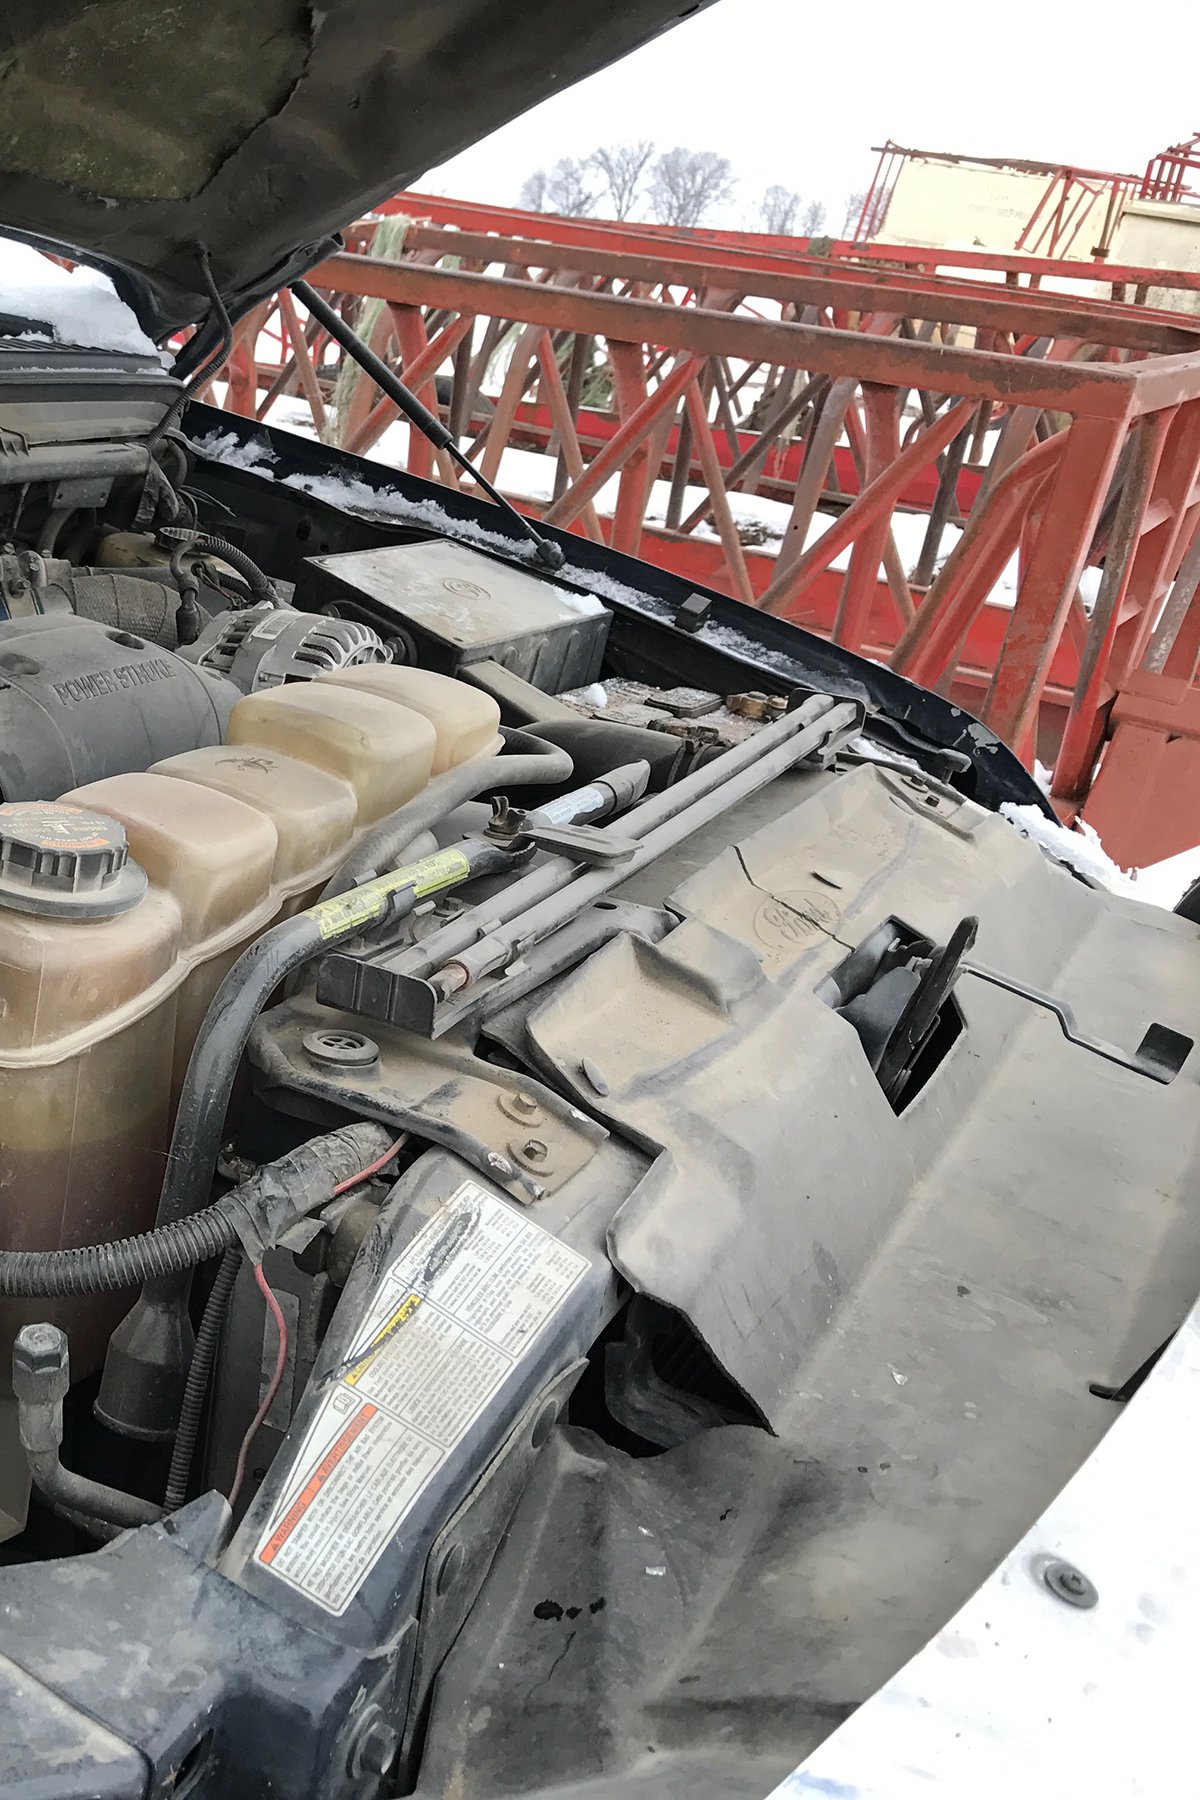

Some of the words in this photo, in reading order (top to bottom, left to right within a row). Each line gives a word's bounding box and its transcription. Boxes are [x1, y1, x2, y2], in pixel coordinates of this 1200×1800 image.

[52, 667, 116, 705] POWER
[113, 657, 178, 691] STROKE
[321, 1411, 368, 1474] AVERTISSEMENT
[275, 1557, 286, 1568] DO
[281, 1544, 294, 1558] NOT
[290, 1521, 309, 1545] TAMPER
[305, 1507, 319, 1522] WITH
[316, 1497, 326, 1507] OR
[322, 1464, 349, 1498] DISCONNECT
[344, 1454, 356, 1465] THE
[352, 1444, 363, 1454] AIR
[367, 1414, 385, 1435] SYSTEM
[274, 1500, 307, 1542] WARNING
